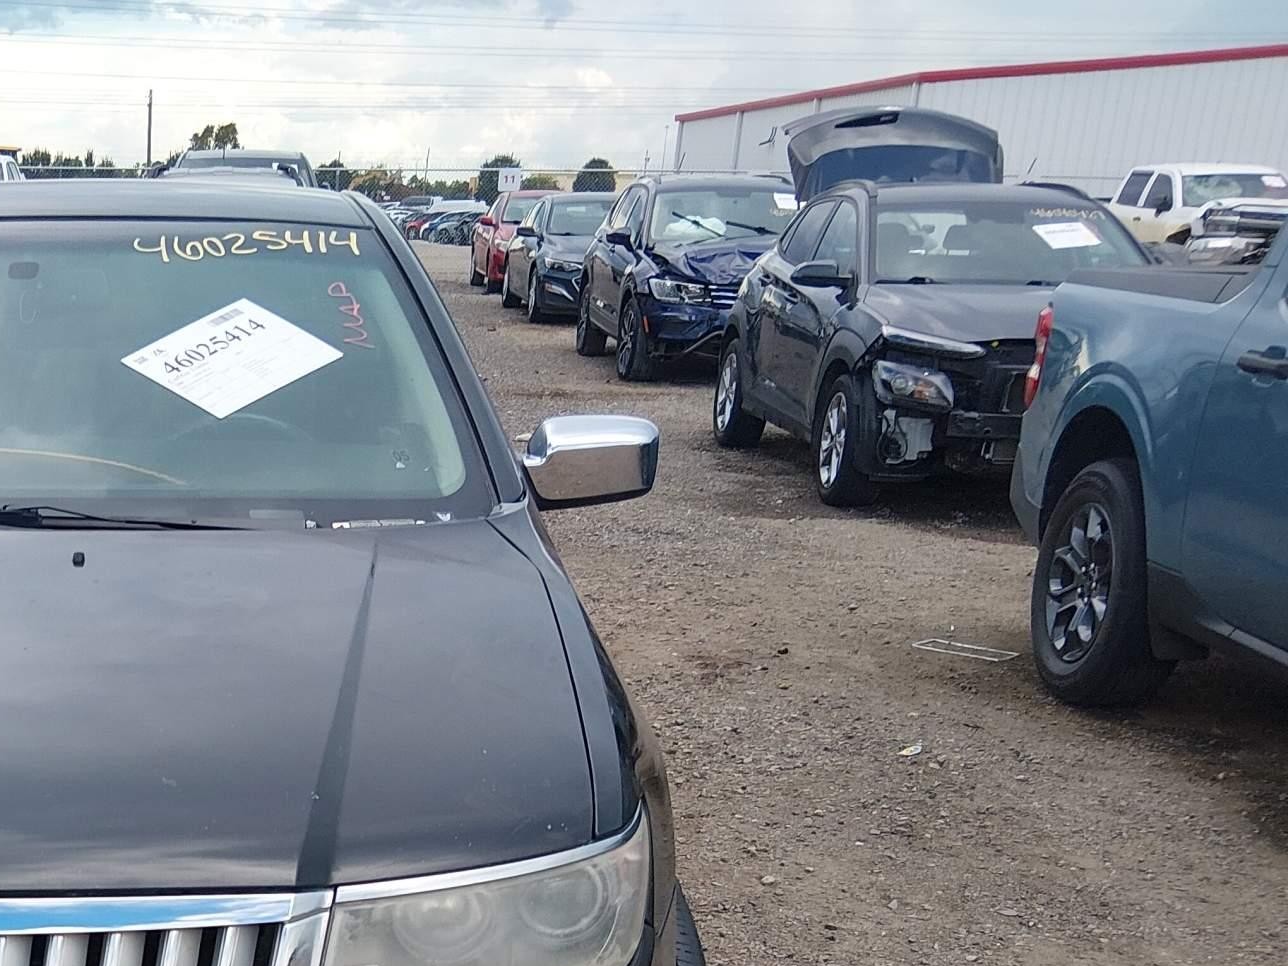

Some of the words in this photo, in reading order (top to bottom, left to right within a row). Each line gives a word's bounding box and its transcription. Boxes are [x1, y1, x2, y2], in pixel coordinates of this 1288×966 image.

[504, 175, 515, 184] 11
[134, 230, 361, 262] 46025414
[163, 318, 266, 377] 46025414
